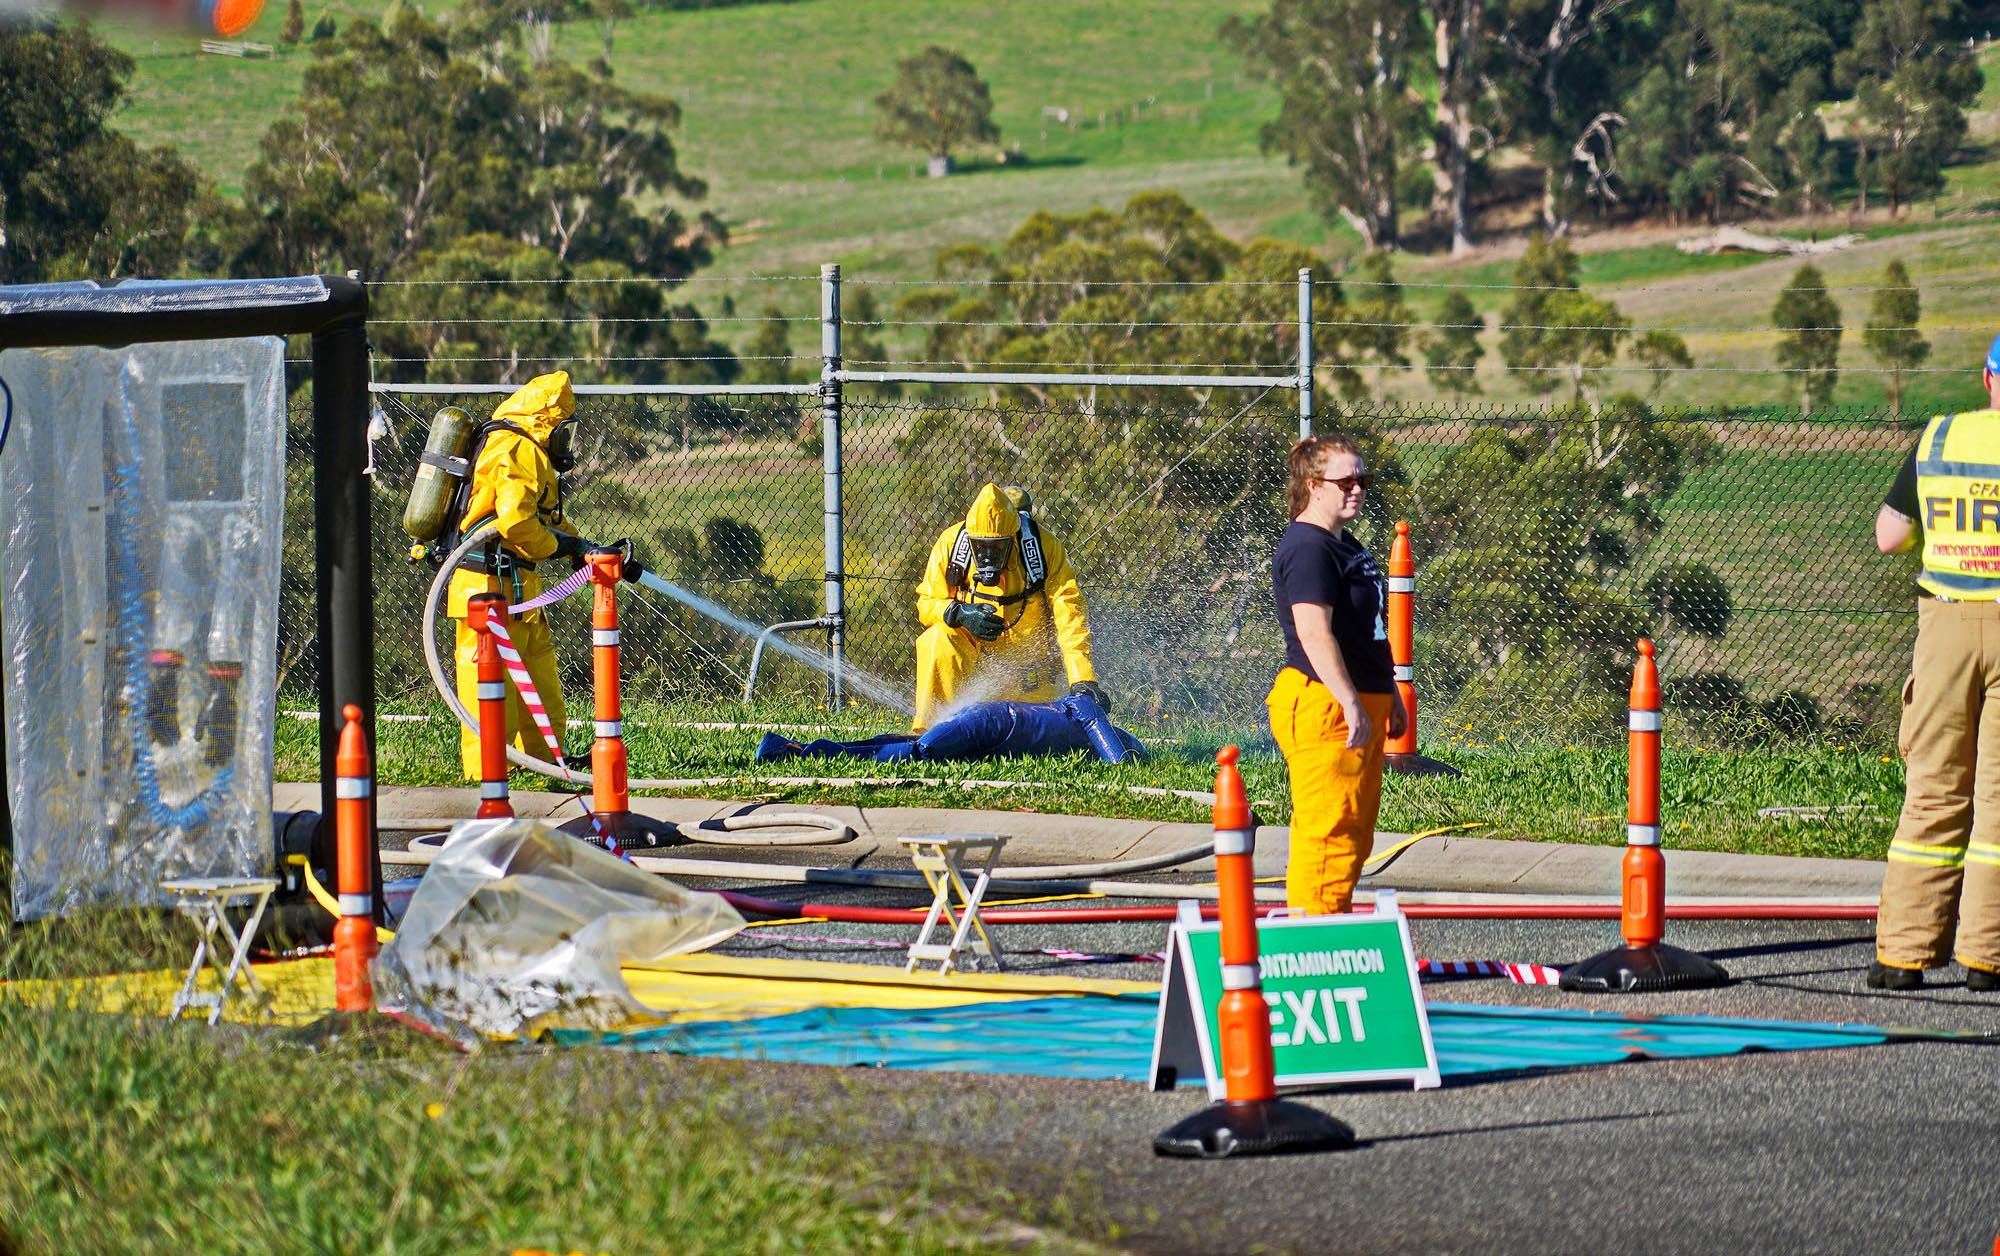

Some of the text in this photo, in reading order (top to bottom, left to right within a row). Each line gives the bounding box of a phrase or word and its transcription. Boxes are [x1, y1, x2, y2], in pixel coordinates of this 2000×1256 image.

[1969, 482, 2000, 497] CFA
[1025, 539, 1040, 568] MSA
[1219, 948, 1385, 981] ONTAMINATION
[1262, 987, 1368, 1047] EXIT
